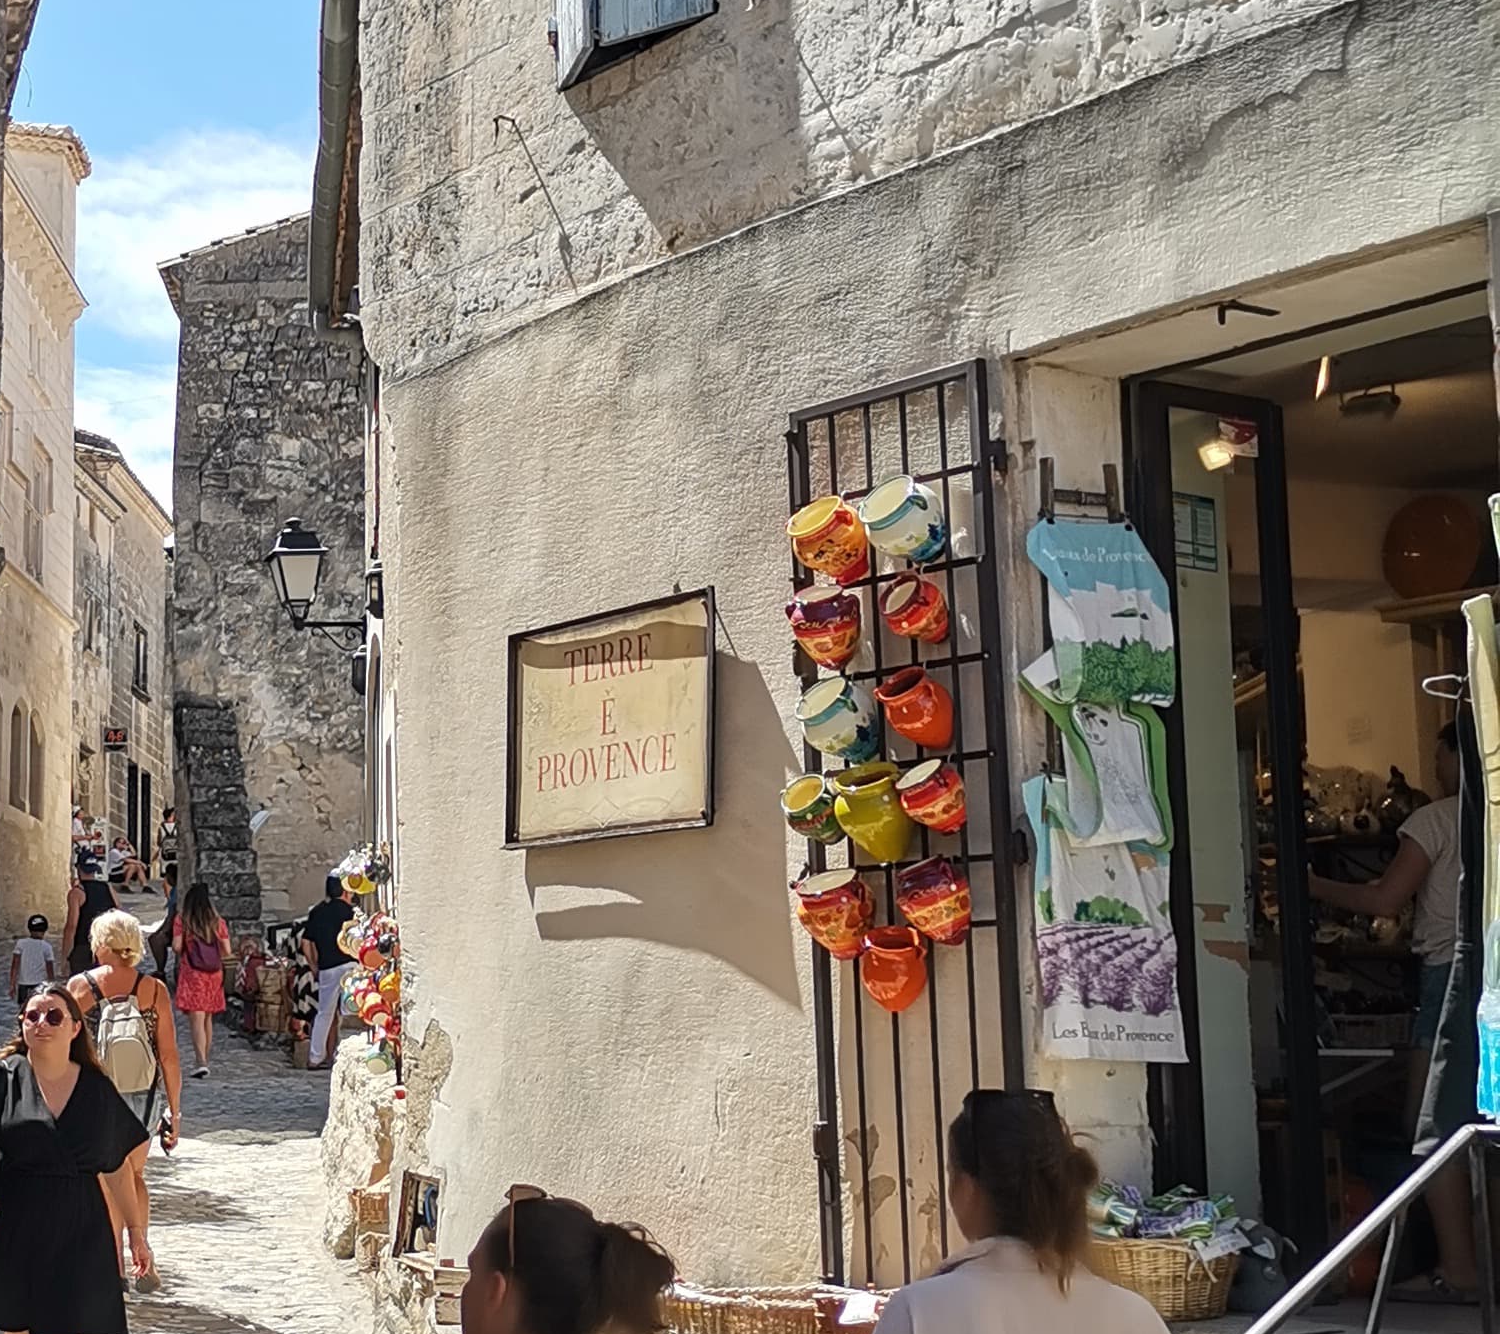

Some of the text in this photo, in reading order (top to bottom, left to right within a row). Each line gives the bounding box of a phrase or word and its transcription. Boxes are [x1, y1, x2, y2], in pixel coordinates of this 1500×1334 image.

[563, 632, 654, 687] TERRE
[537, 732, 677, 793] PROVENCE
[1052, 1021, 1079, 1040] Les
[1100, 1024, 1116, 1041] de
[1116, 1024, 1175, 1043] Provence
